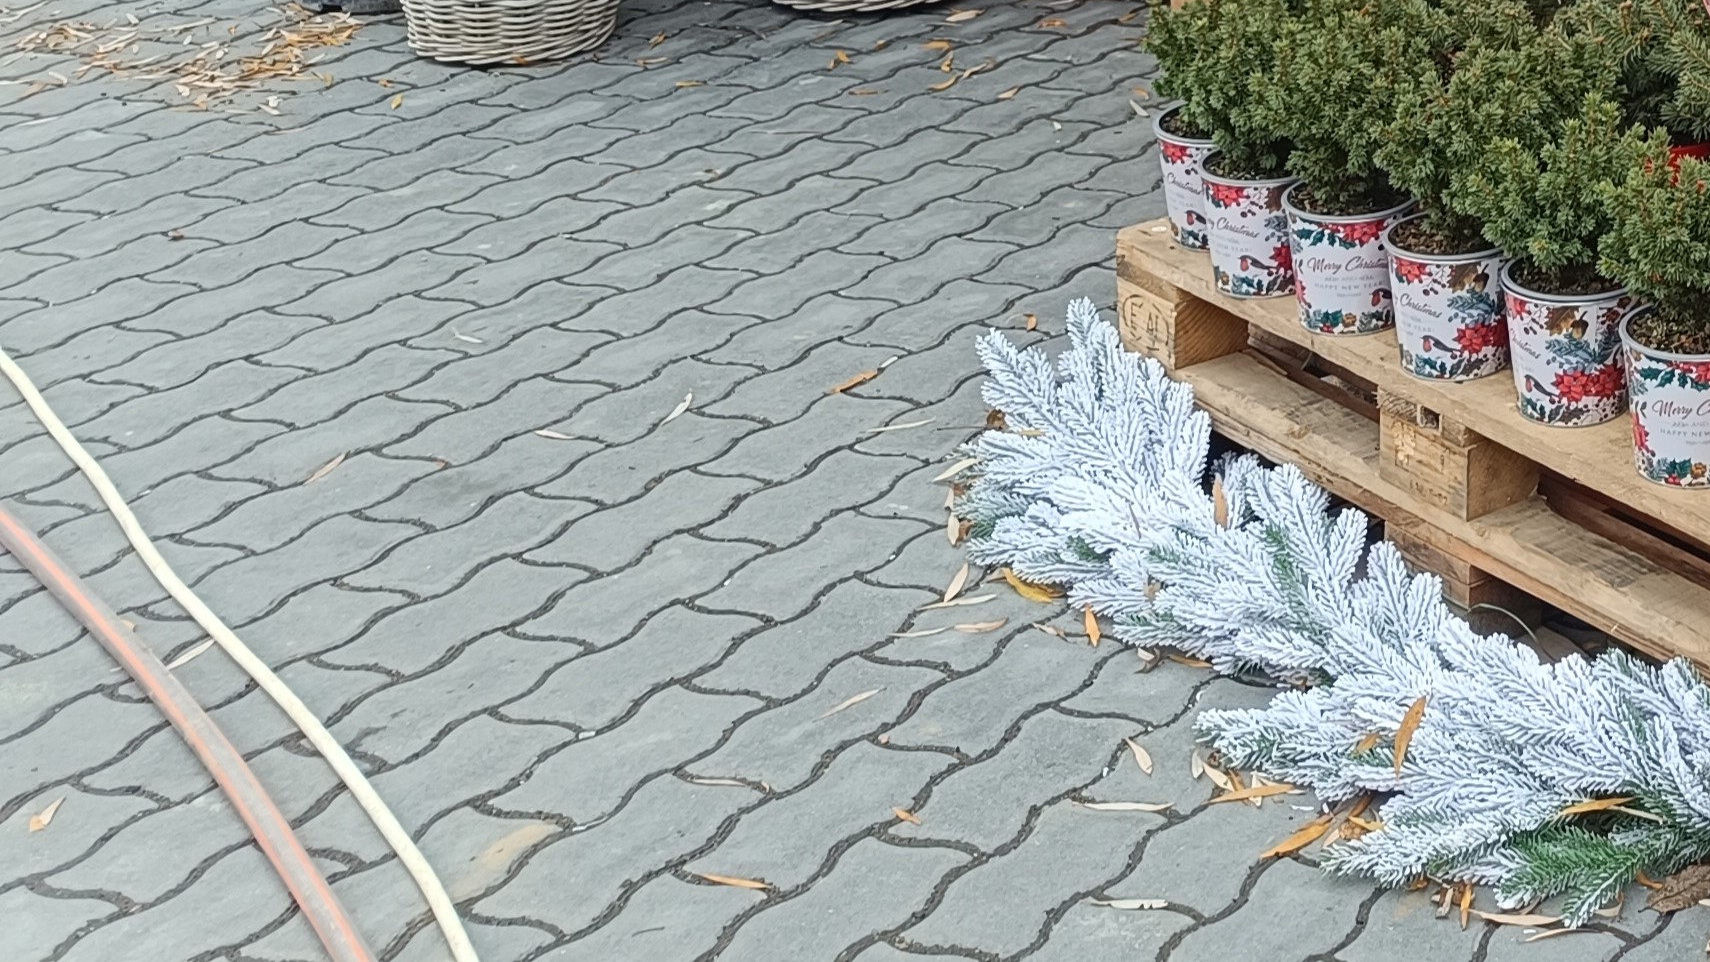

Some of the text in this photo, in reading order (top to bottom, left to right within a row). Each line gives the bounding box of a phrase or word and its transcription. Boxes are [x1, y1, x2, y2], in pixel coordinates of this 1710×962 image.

[1167, 172, 1203, 195] Christmas
[1217, 217, 1260, 238] Christmas
[1307, 256, 1342, 275] Merry
[1399, 292, 1443, 319] Christmas
[1652, 399, 1693, 420] Merry
[1660, 428, 1687, 437] HAPPY
